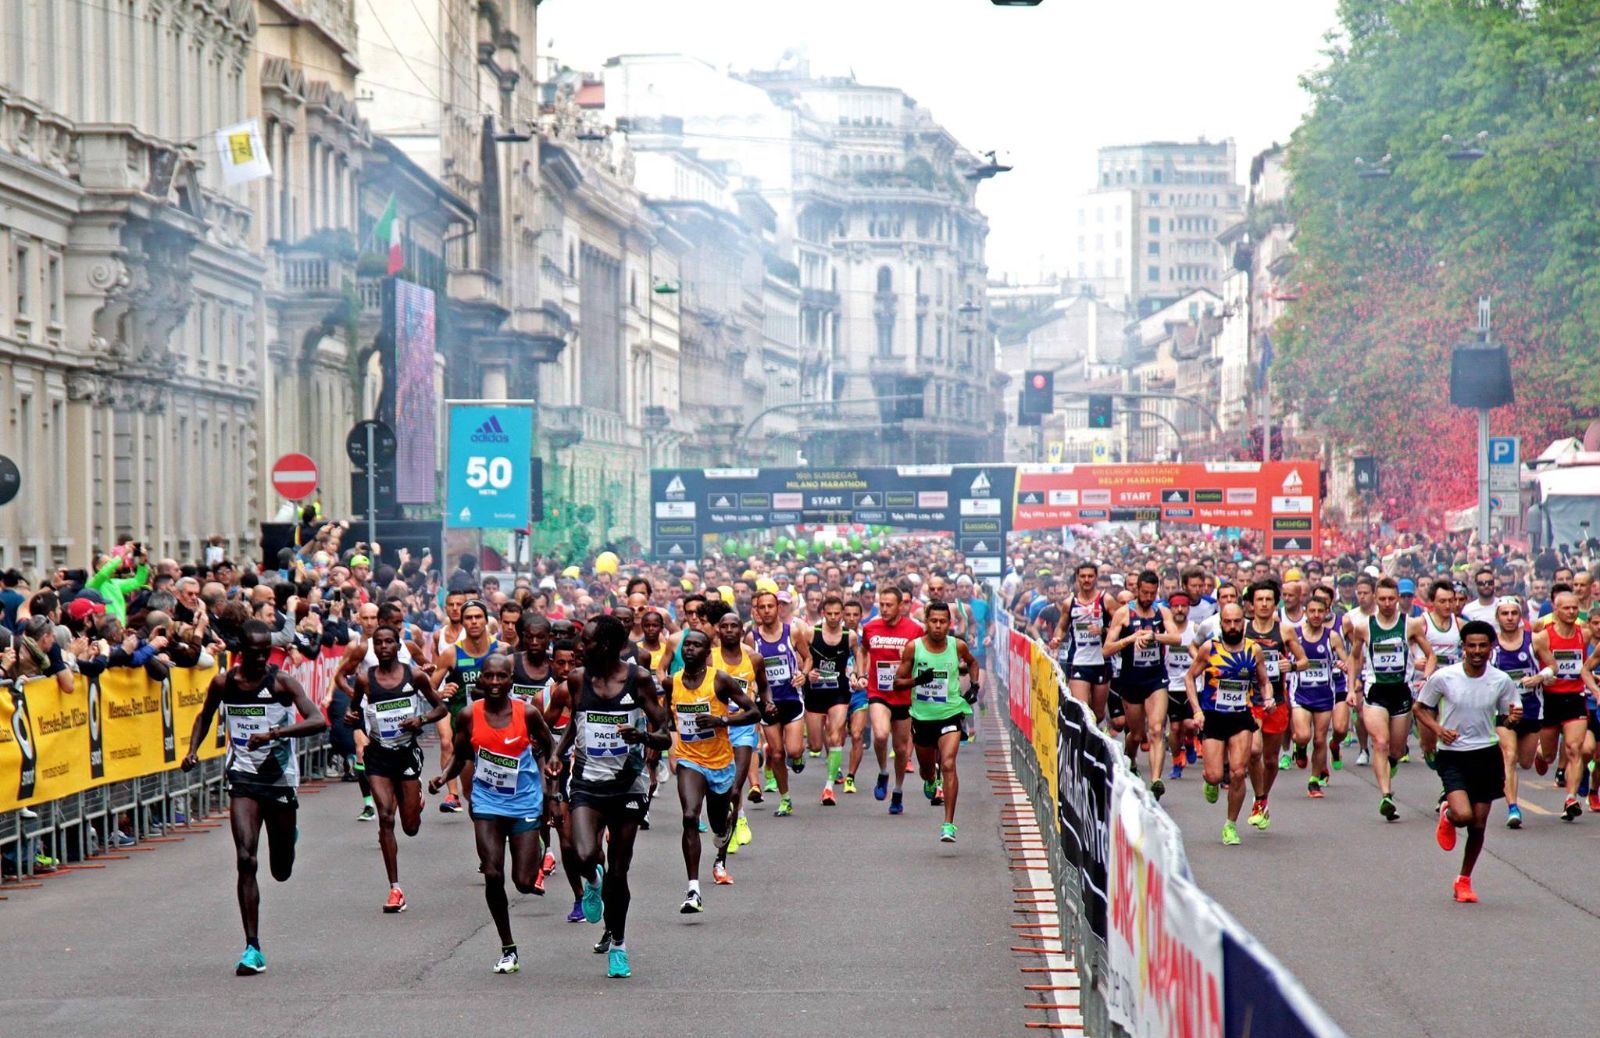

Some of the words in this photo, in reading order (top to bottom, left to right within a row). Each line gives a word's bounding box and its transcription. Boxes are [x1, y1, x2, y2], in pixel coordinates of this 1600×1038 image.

[470, 433, 509, 443] adidas
[1494, 442, 1509, 462] P
[466, 456, 512, 489] 50
[786, 481, 819, 489] MILANO
[820, 480, 867, 488] MARATHON
[1098, 477, 1124, 486] RELAY
[1126, 476, 1174, 485] MARATHON
[811, 496, 842, 505] START
[1119, 492, 1152, 502] START
[1381, 655, 1397, 663] 572
[1559, 662, 1576, 670] 654
[1223, 693, 1242, 702] 1564
[377, 700, 410, 711] SuisseGas
[229, 706, 264, 716] SuisseGas
[588, 713, 627, 723] SuisseGas
[237, 723, 260, 731] PACER
[594, 732, 621, 740] PACER
[480, 750, 517, 768] SuisseGas
[483, 767, 508, 779] PACER
